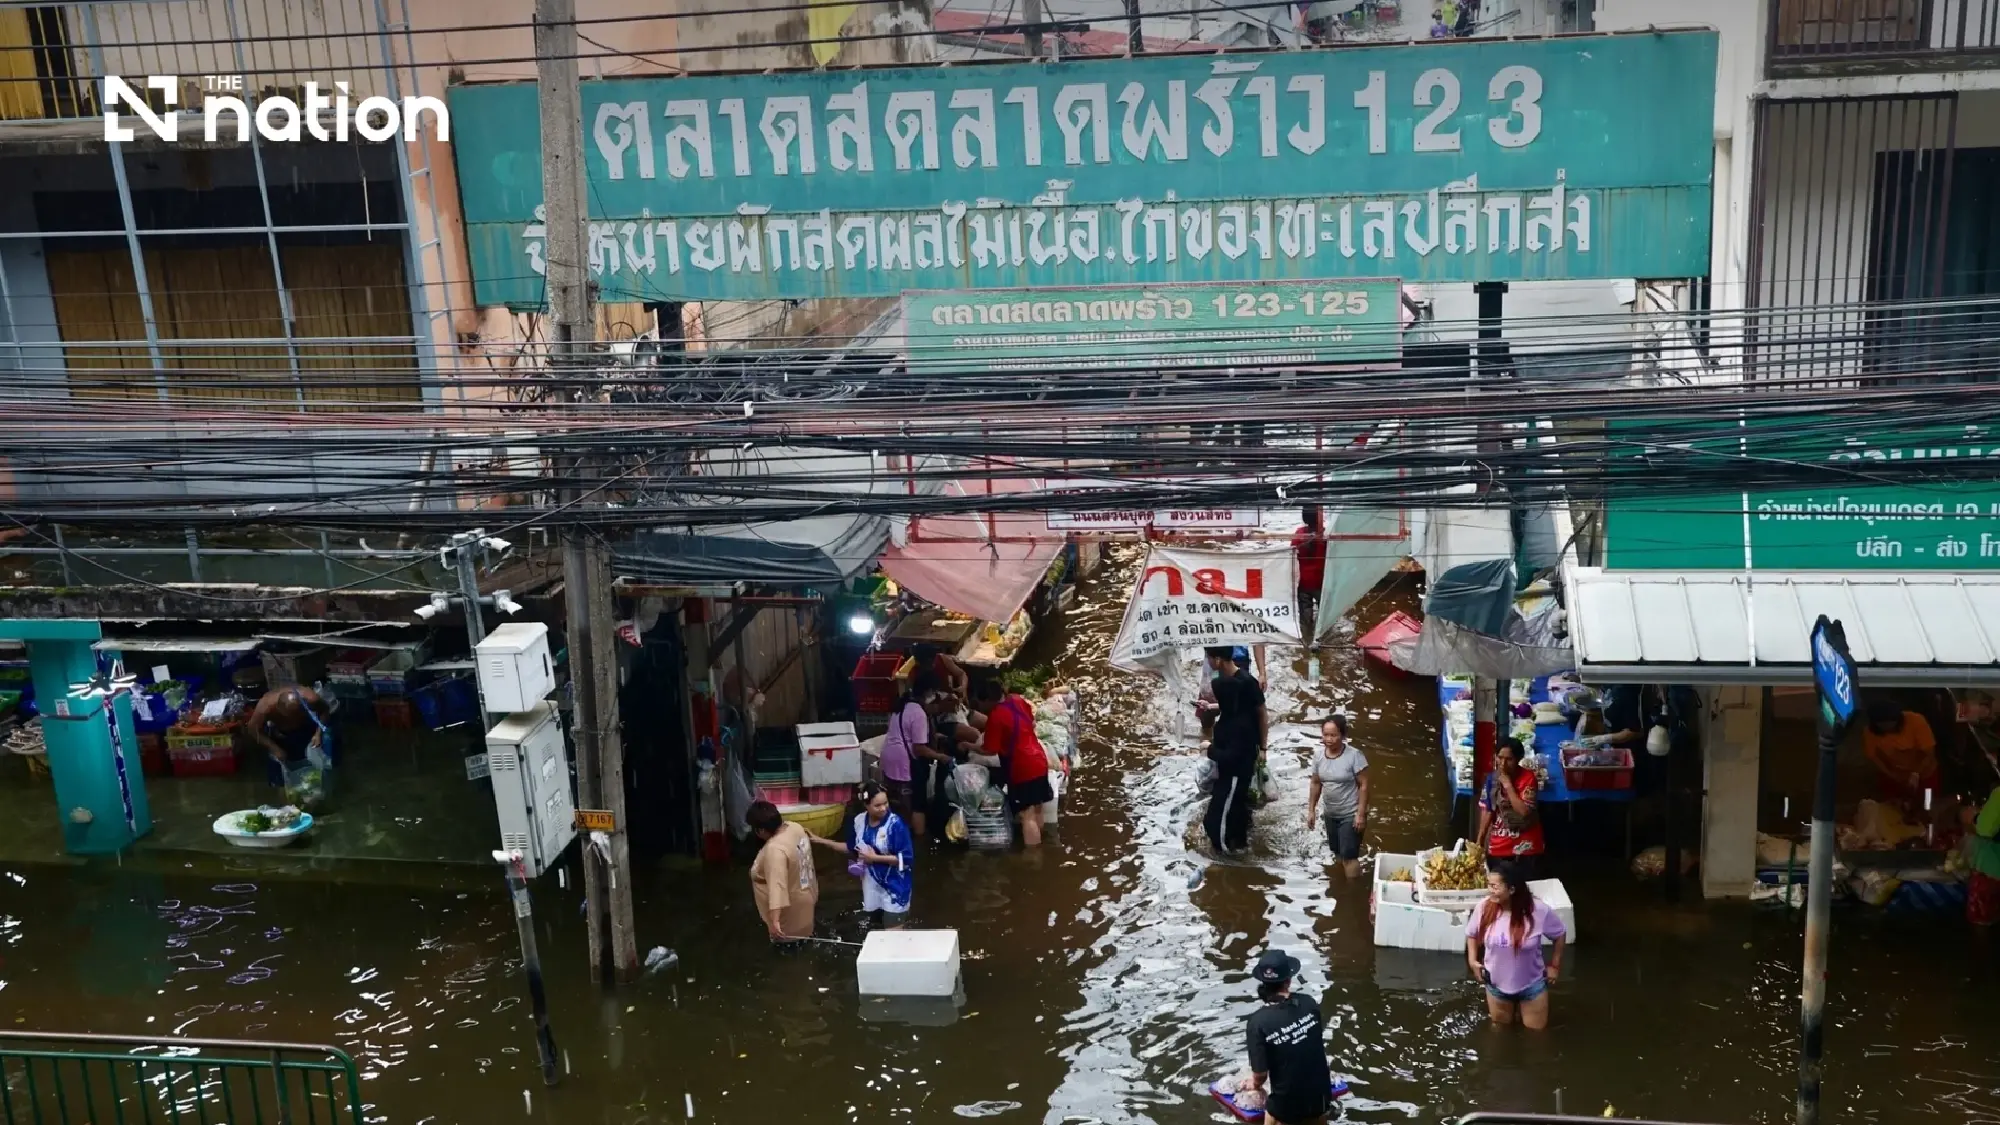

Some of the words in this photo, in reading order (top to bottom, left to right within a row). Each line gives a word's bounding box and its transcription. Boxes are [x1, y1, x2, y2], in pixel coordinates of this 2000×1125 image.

[594, 61, 1326, 180] ตลาดสดลาดพร้าว
[1354, 65, 1543, 154] 123
[931, 291, 1192, 326] ตลาดสดลาดพร้าว
[1211, 290, 1369, 318] 123-125
[1856, 535, 1902, 557] ปลีก
[1936, 535, 1968, 557] ส่ง
[1163, 626, 1171, 636] 4
[1178, 616, 1225, 636] ล้อเล็ก
[1835, 662, 1850, 705] 123
